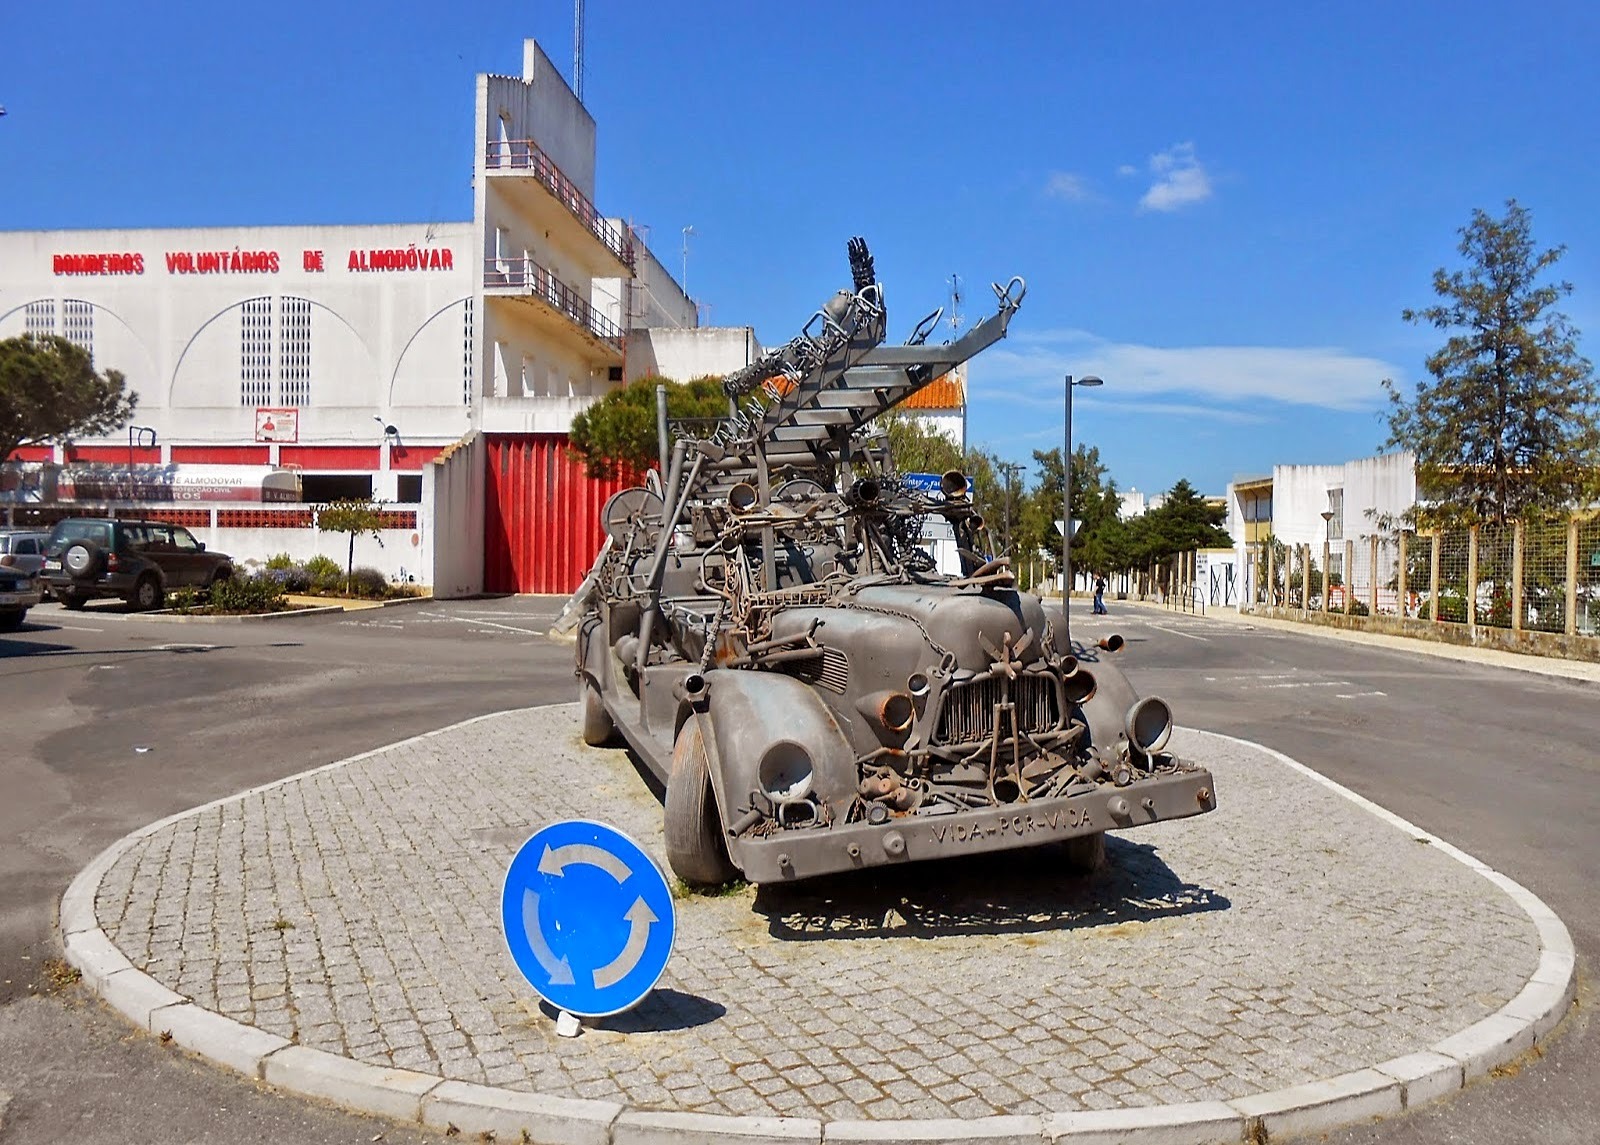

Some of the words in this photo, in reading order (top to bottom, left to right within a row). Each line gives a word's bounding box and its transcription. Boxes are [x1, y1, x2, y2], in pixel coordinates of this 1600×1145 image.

[53, 253, 144, 276] BOMBEIROS
[165, 246, 280, 274] VOLUNTÁRIOS
[303, 250, 325, 272] DE
